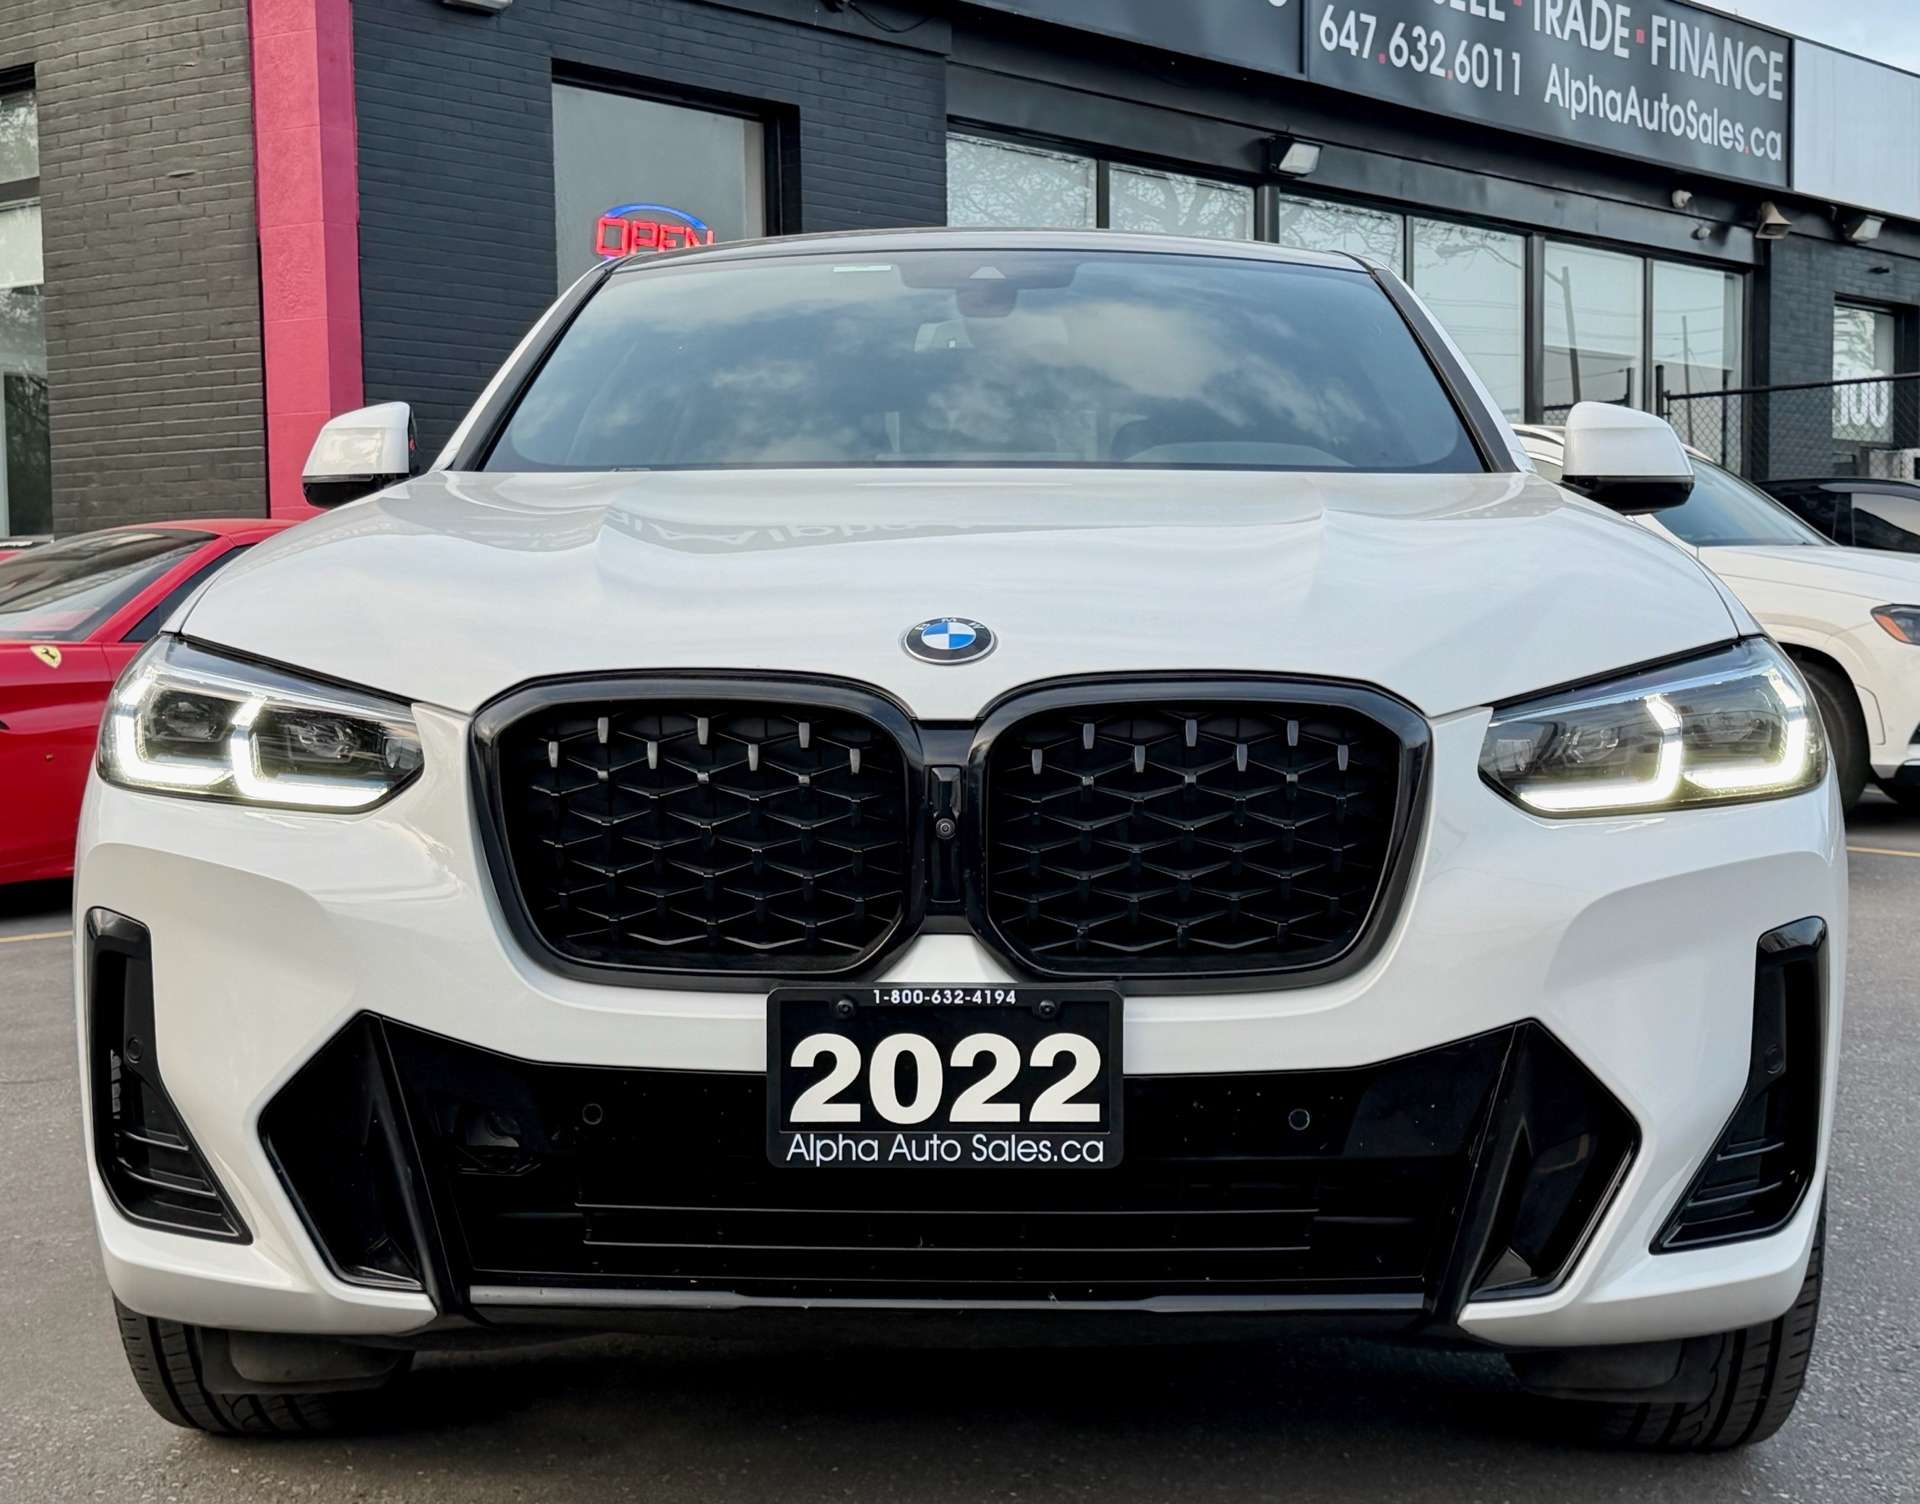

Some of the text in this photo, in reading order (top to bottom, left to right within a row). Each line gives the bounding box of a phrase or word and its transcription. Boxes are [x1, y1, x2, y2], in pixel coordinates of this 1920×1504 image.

[1319, 4, 1521, 96] 647.632.6011
[1651, 14, 1784, 101] FINANCE
[1544, 63, 1782, 161] AlphaAutoSales.ca
[873, 989, 1016, 1005] 1-800-632-4194
[789, 1032, 1101, 1124] 2022
[786, 1134, 1104, 1167] Alpha Auto Sales.ca
